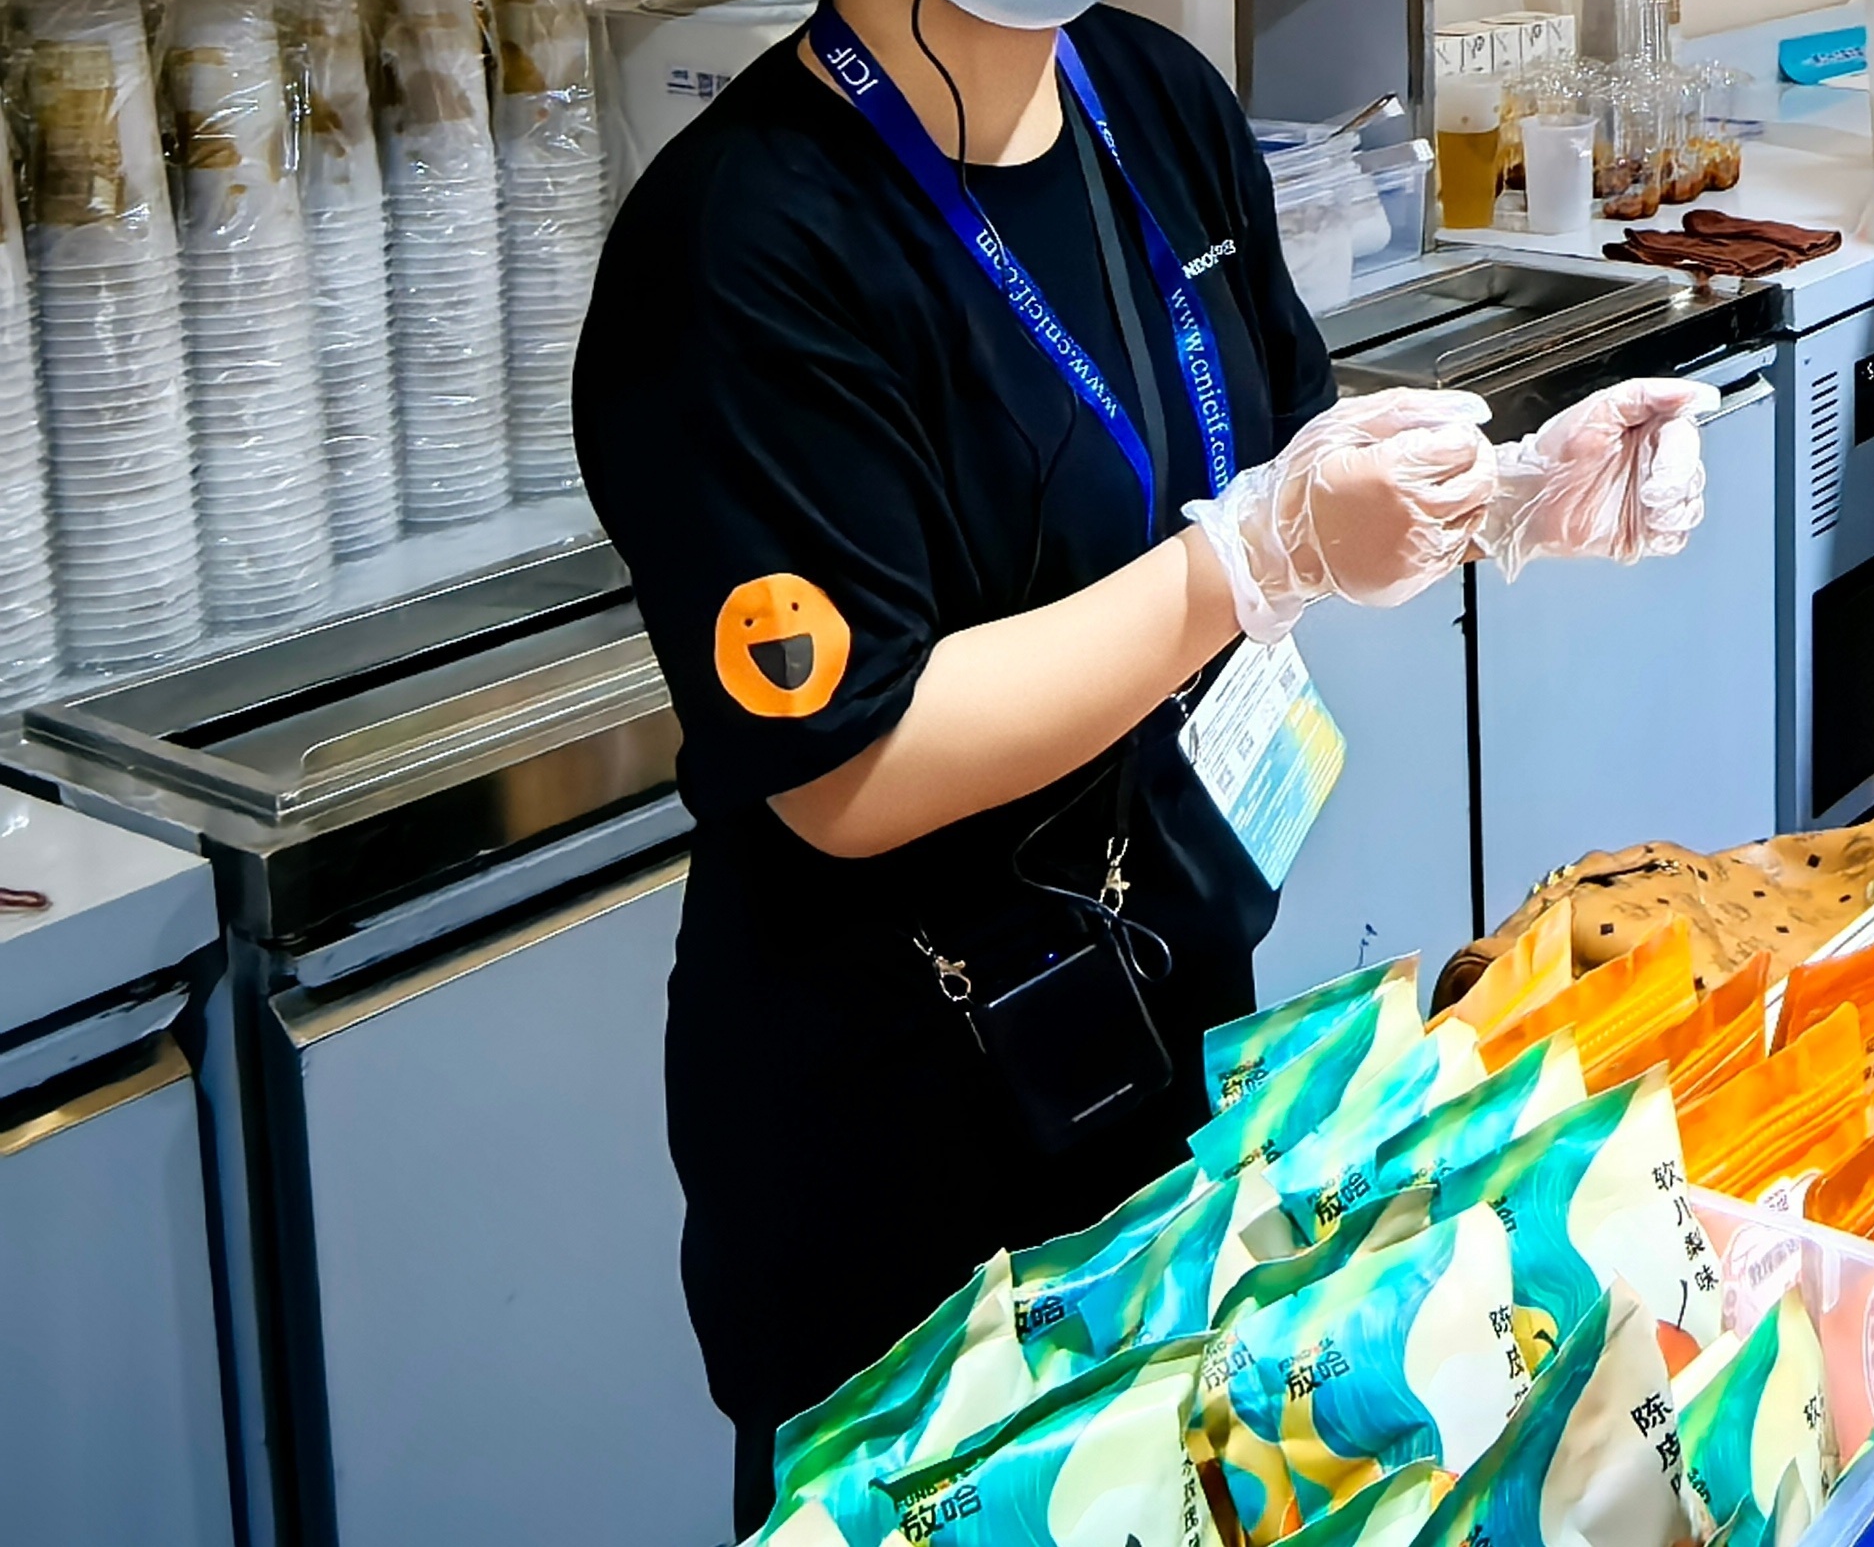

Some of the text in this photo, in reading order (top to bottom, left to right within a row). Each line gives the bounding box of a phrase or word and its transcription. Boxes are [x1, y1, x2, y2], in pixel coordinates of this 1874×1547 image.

[826, 47, 879, 95] ICIF
[1314, 1171, 1371, 1227] 放哈
[1286, 1349, 1351, 1402] 放哈
[899, 1481, 982, 1543] 放哈
